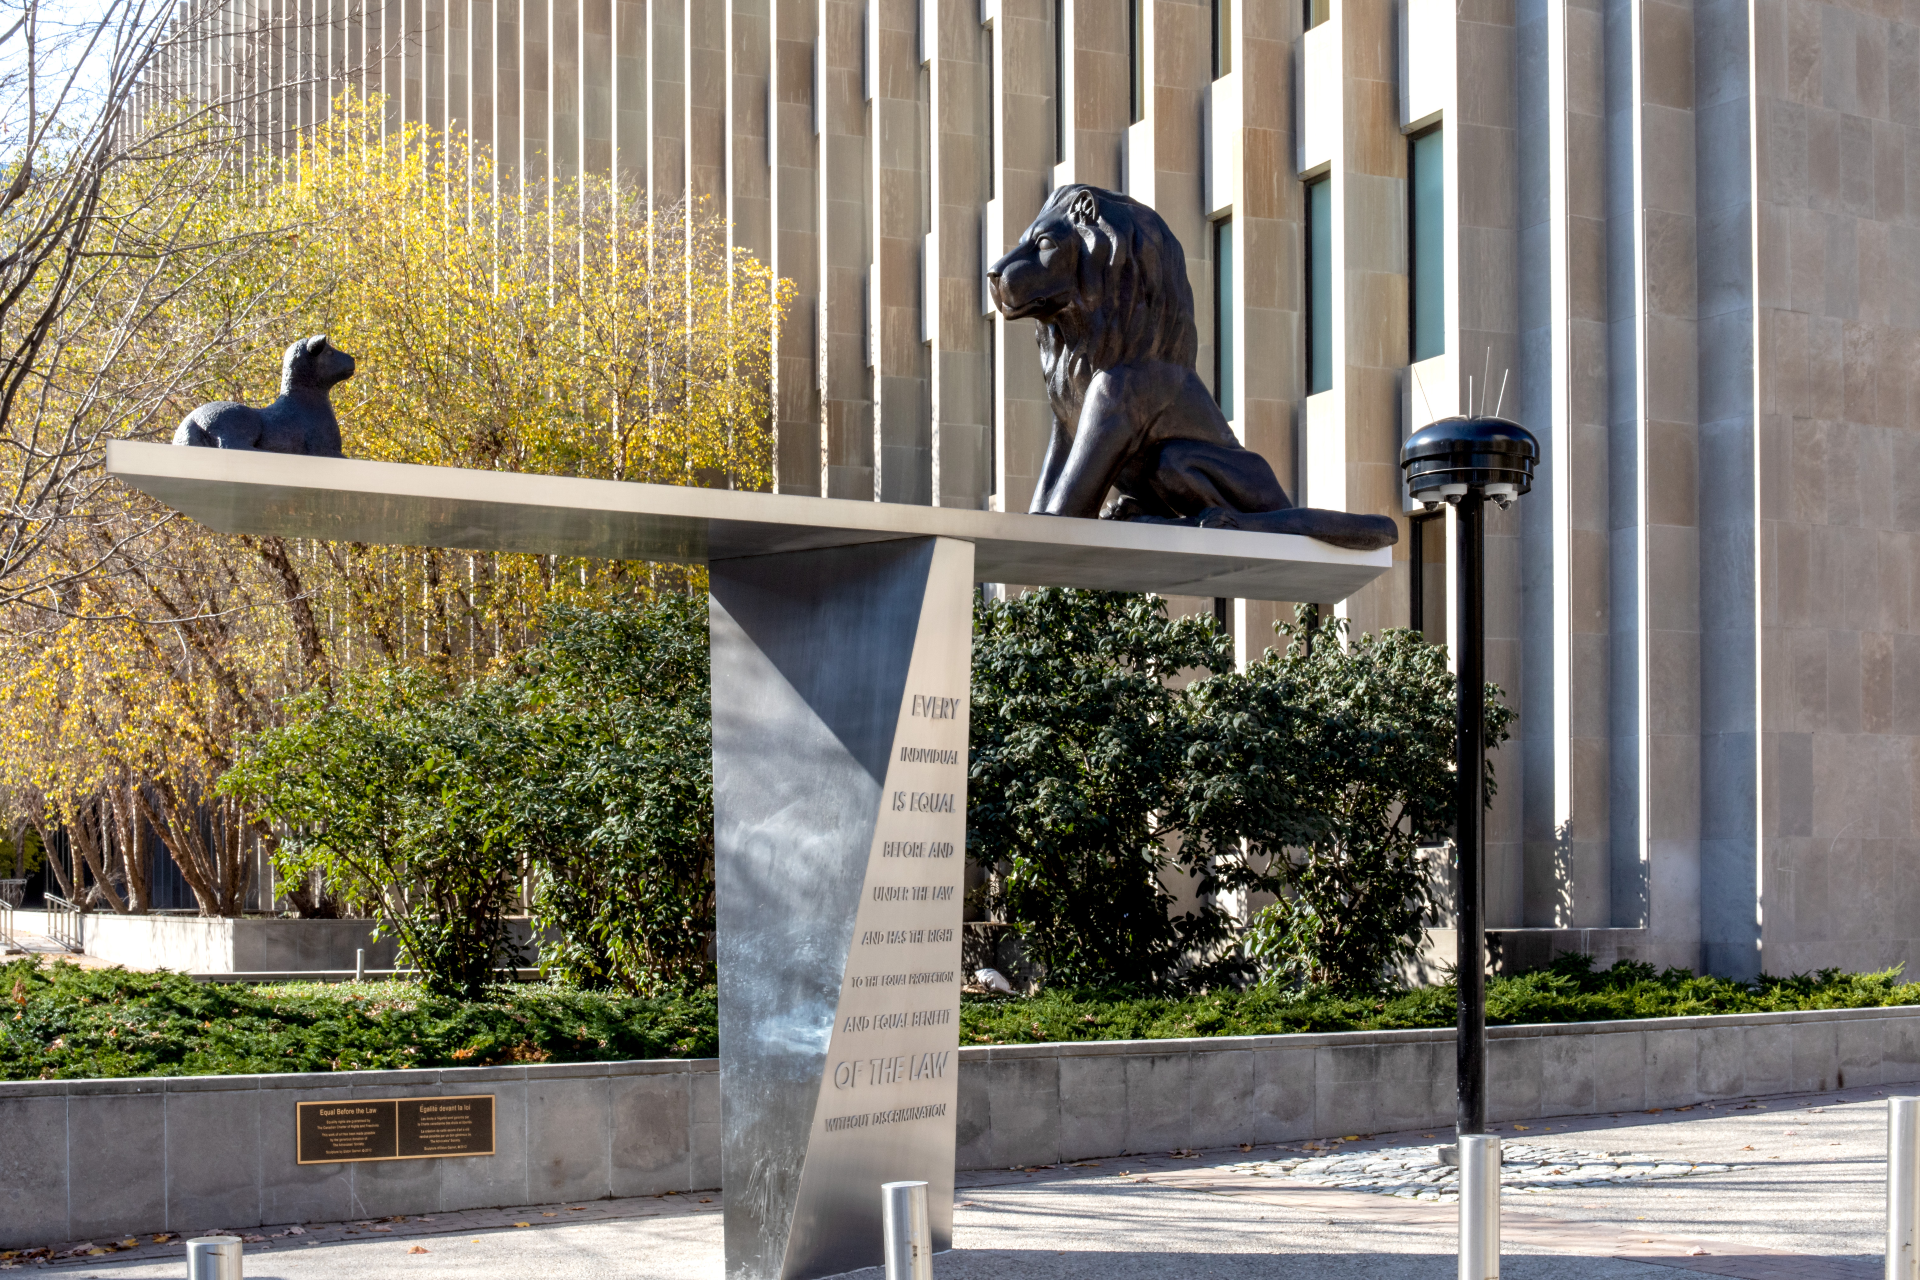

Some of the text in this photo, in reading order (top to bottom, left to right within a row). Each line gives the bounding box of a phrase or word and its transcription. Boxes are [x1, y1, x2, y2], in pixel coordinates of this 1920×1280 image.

[911, 694, 961, 720] EVERY
[900, 746, 959, 765] INDIVIDUAL
[892, 791, 956, 814] IS EQUAL
[883, 841, 954, 858] BEFORE AND
[873, 885, 954, 902] UNDER THE LAW
[861, 928, 954, 946] AND HAS THE RIGHT
[851, 976, 863, 988] TO
[881, 974, 908, 987] EQUAL
[908, 971, 954, 985] PROTECTION
[842, 1009, 952, 1033] AND EQUAL BENEFIT
[834, 1050, 951, 1090] OF THE LAW
[319, 1108, 336, 1117] Equal
[419, 1103, 438, 1114] Égalité
[439, 1104, 457, 1112] devant
[463, 1103, 471, 1111] loi
[825, 1103, 946, 1132] WITHOUT DISCRIMINATION
